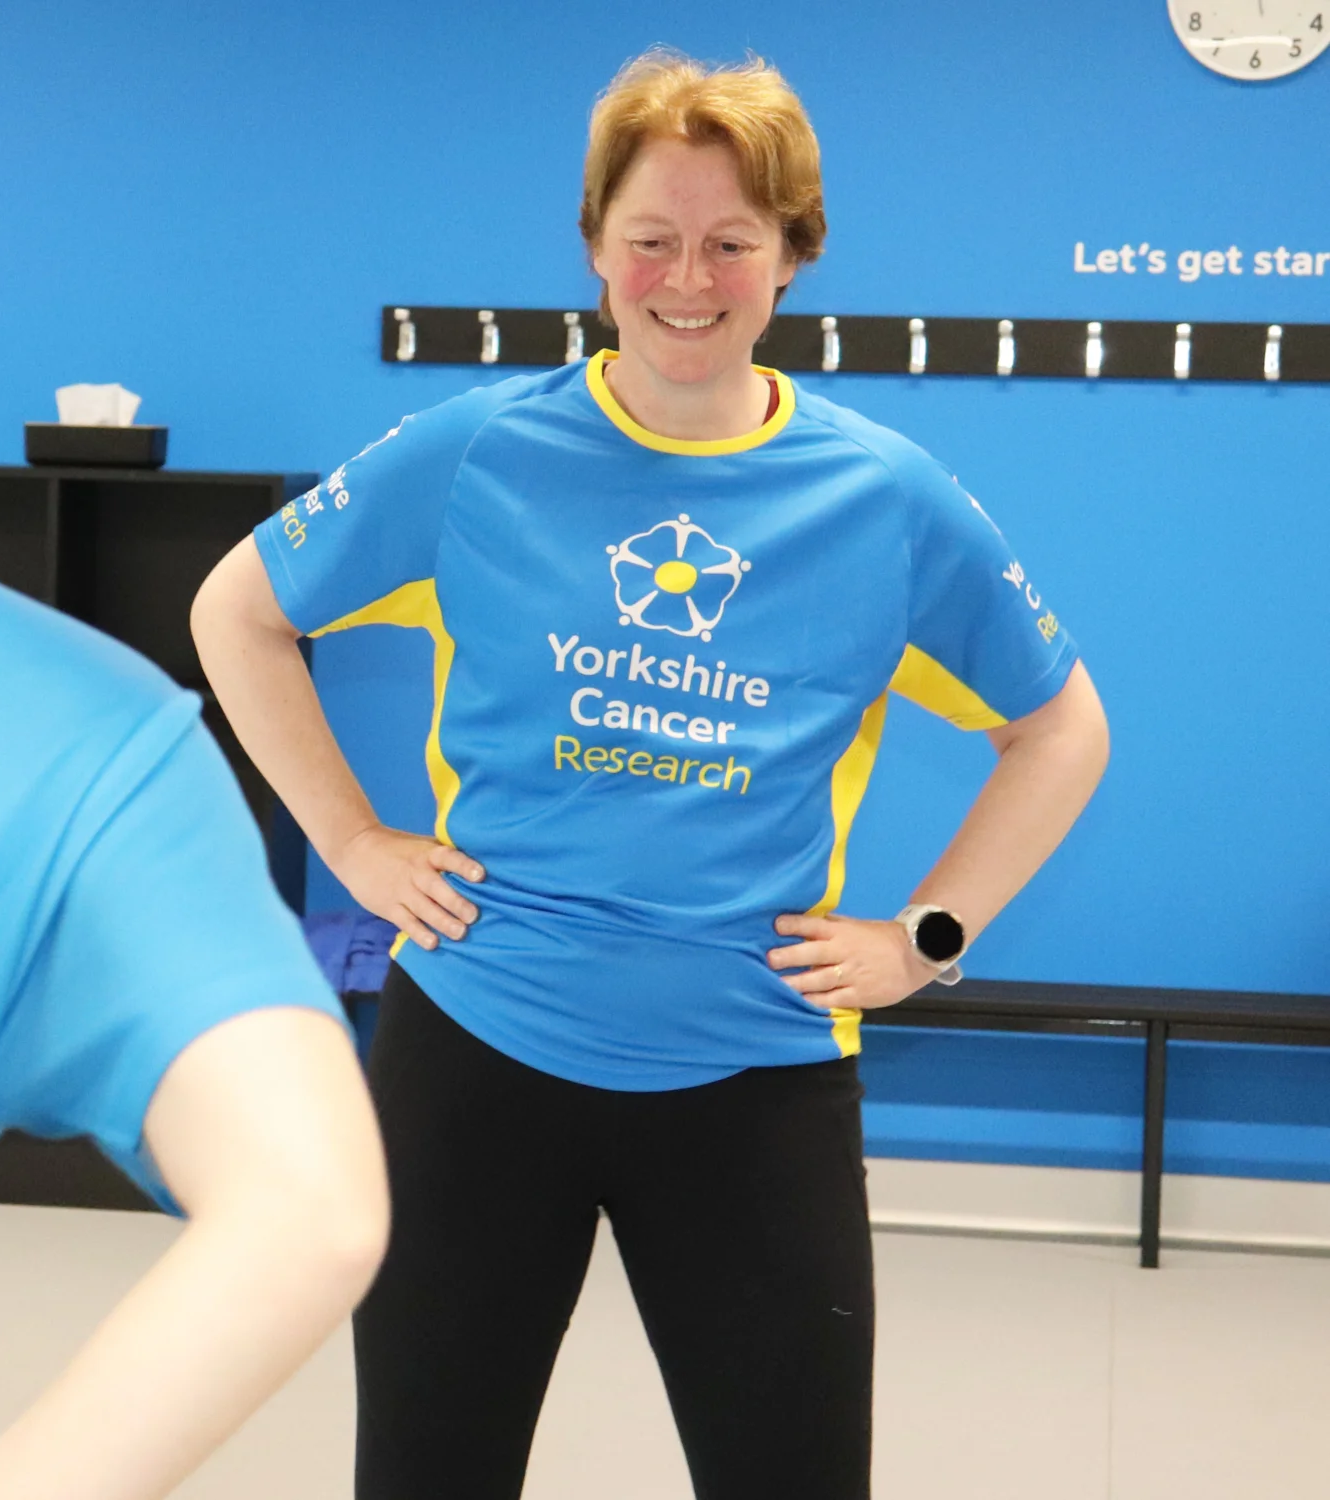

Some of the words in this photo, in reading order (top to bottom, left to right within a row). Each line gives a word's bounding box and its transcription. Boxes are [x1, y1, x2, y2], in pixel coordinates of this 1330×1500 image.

[1188, 11, 1202, 32] 8
[1309, 12, 1324, 33] 4
[1248, 48, 1262, 70] 6
[1288, 38, 1302, 58] 5
[1177, 245, 1243, 283] get
[547, 632, 771, 708] Yorkshire
[569, 687, 737, 745] Cancer
[553, 734, 753, 796] Research
